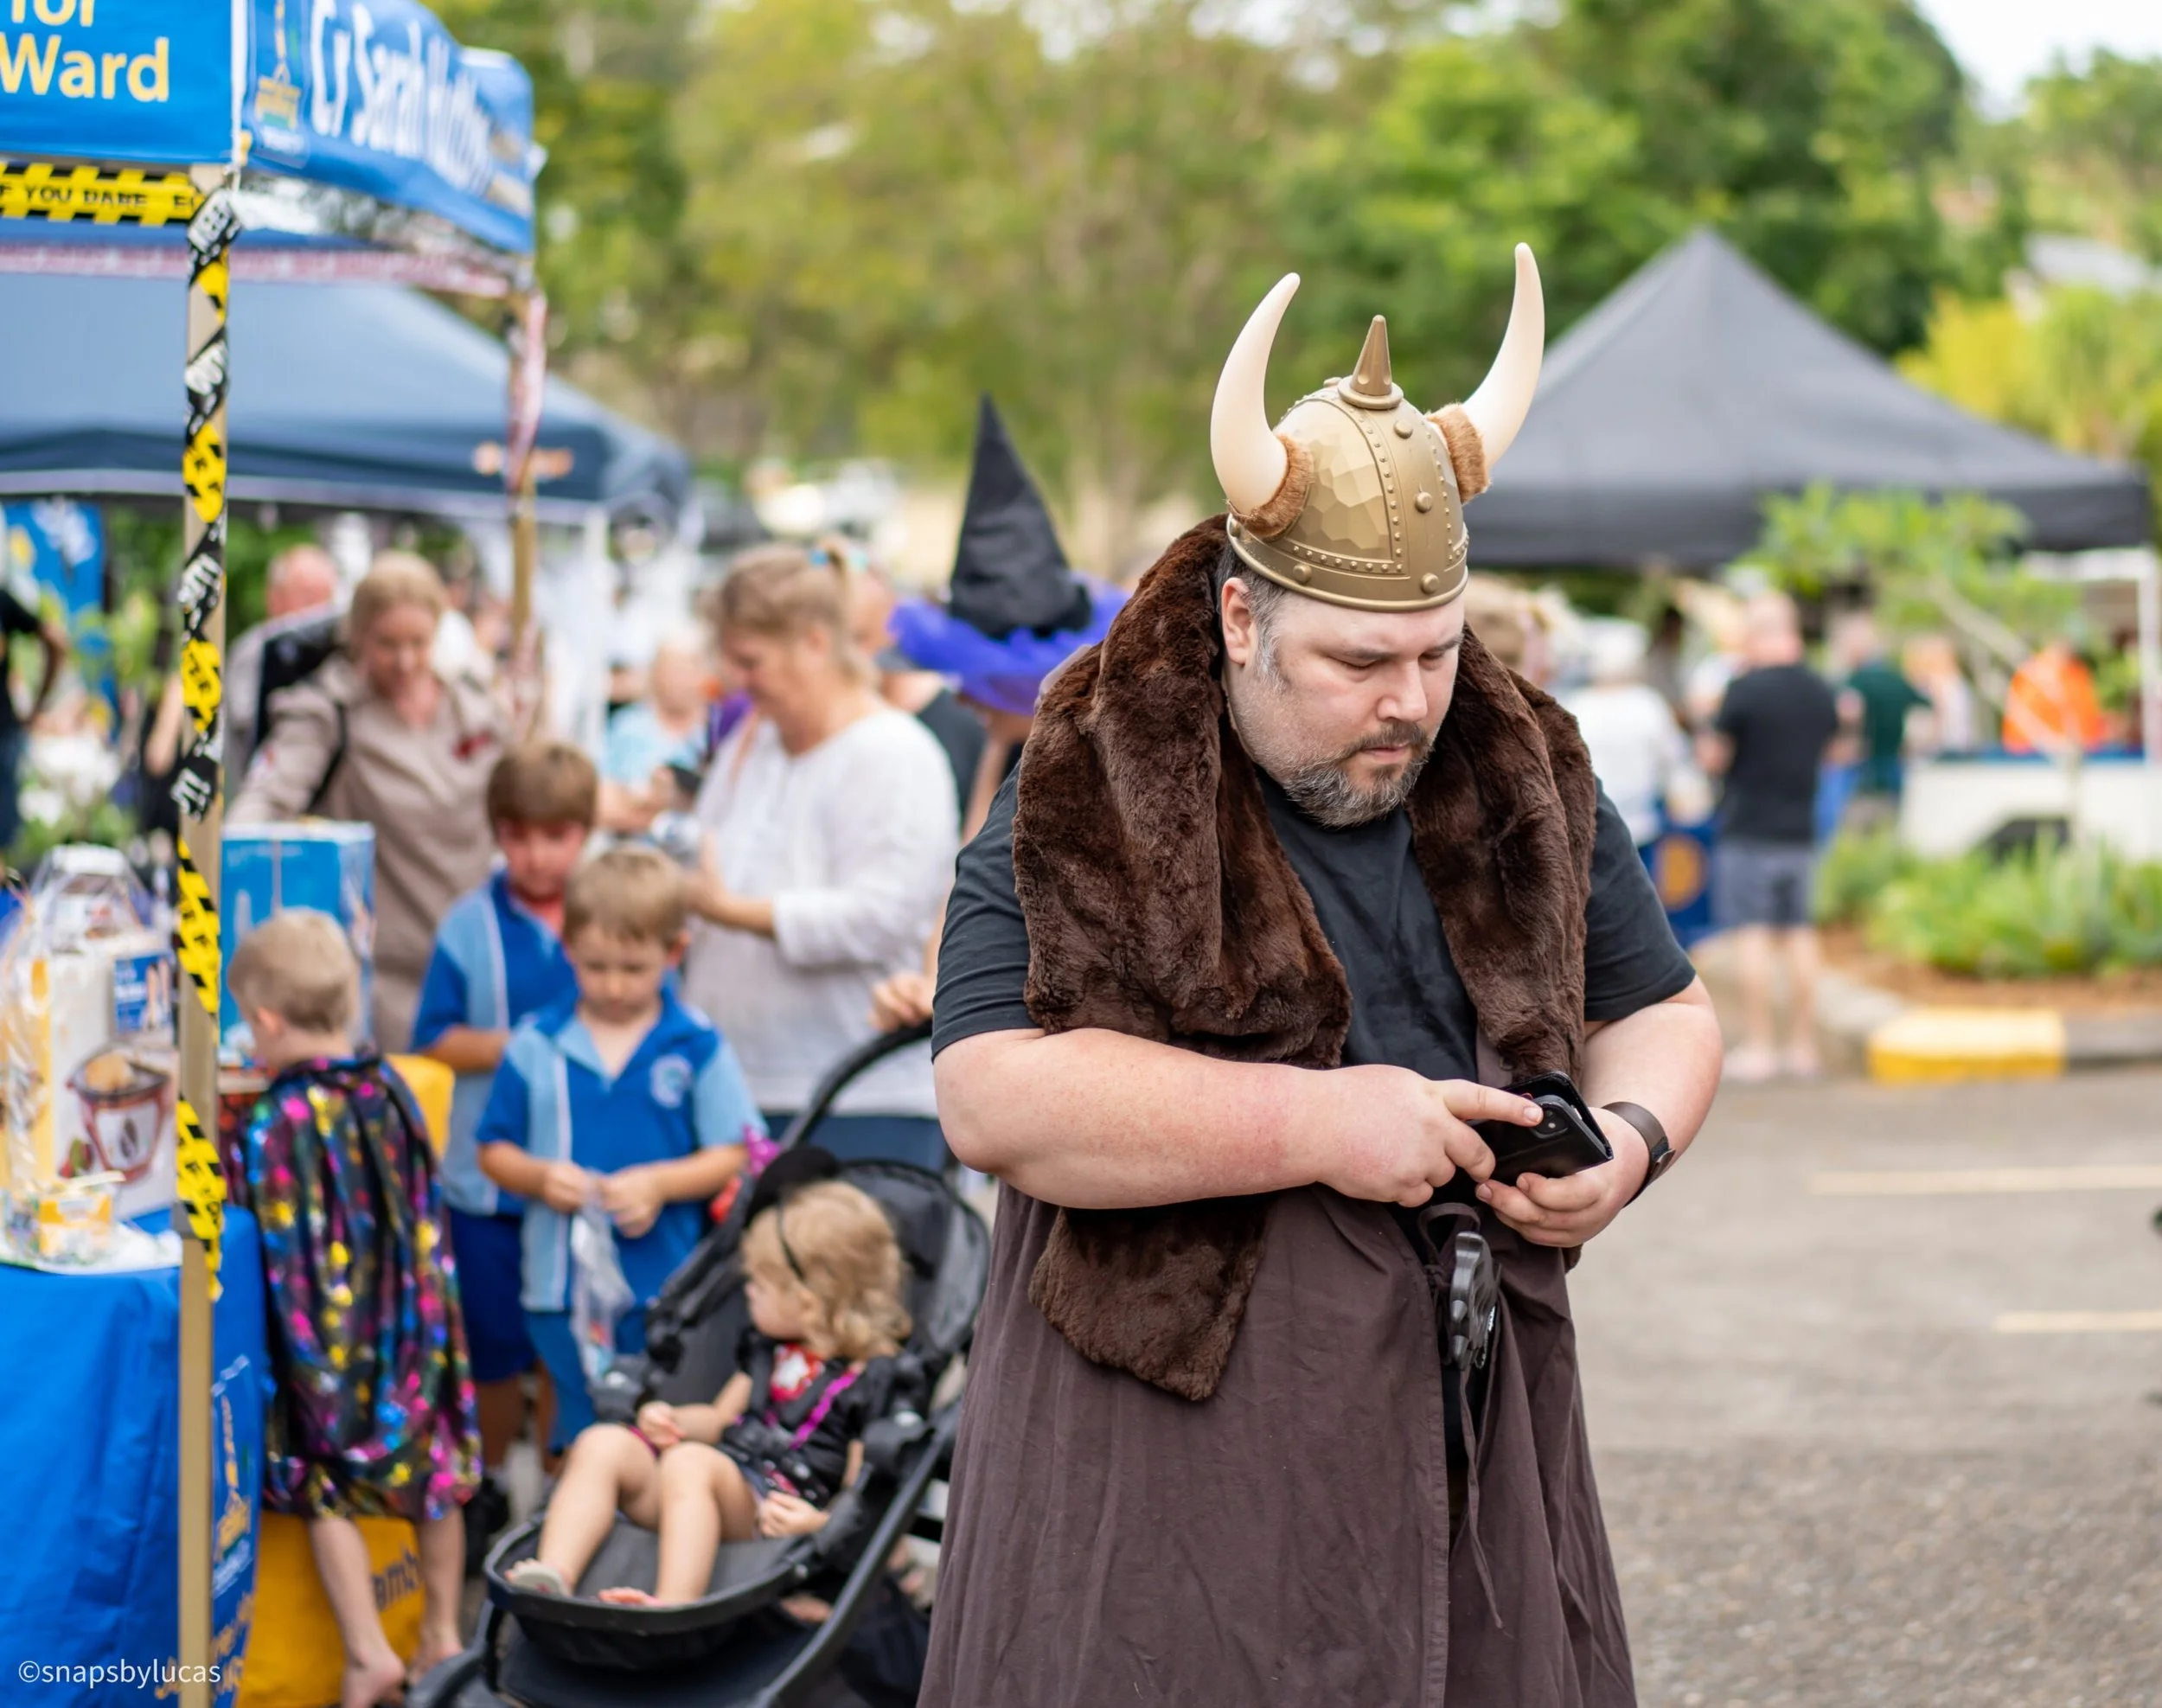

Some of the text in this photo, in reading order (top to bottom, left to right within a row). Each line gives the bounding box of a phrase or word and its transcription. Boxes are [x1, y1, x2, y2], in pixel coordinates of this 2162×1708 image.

[0, 32, 170, 103] Ward
[24, 184, 73, 202] YOU
[83, 188, 149, 208] DARE
